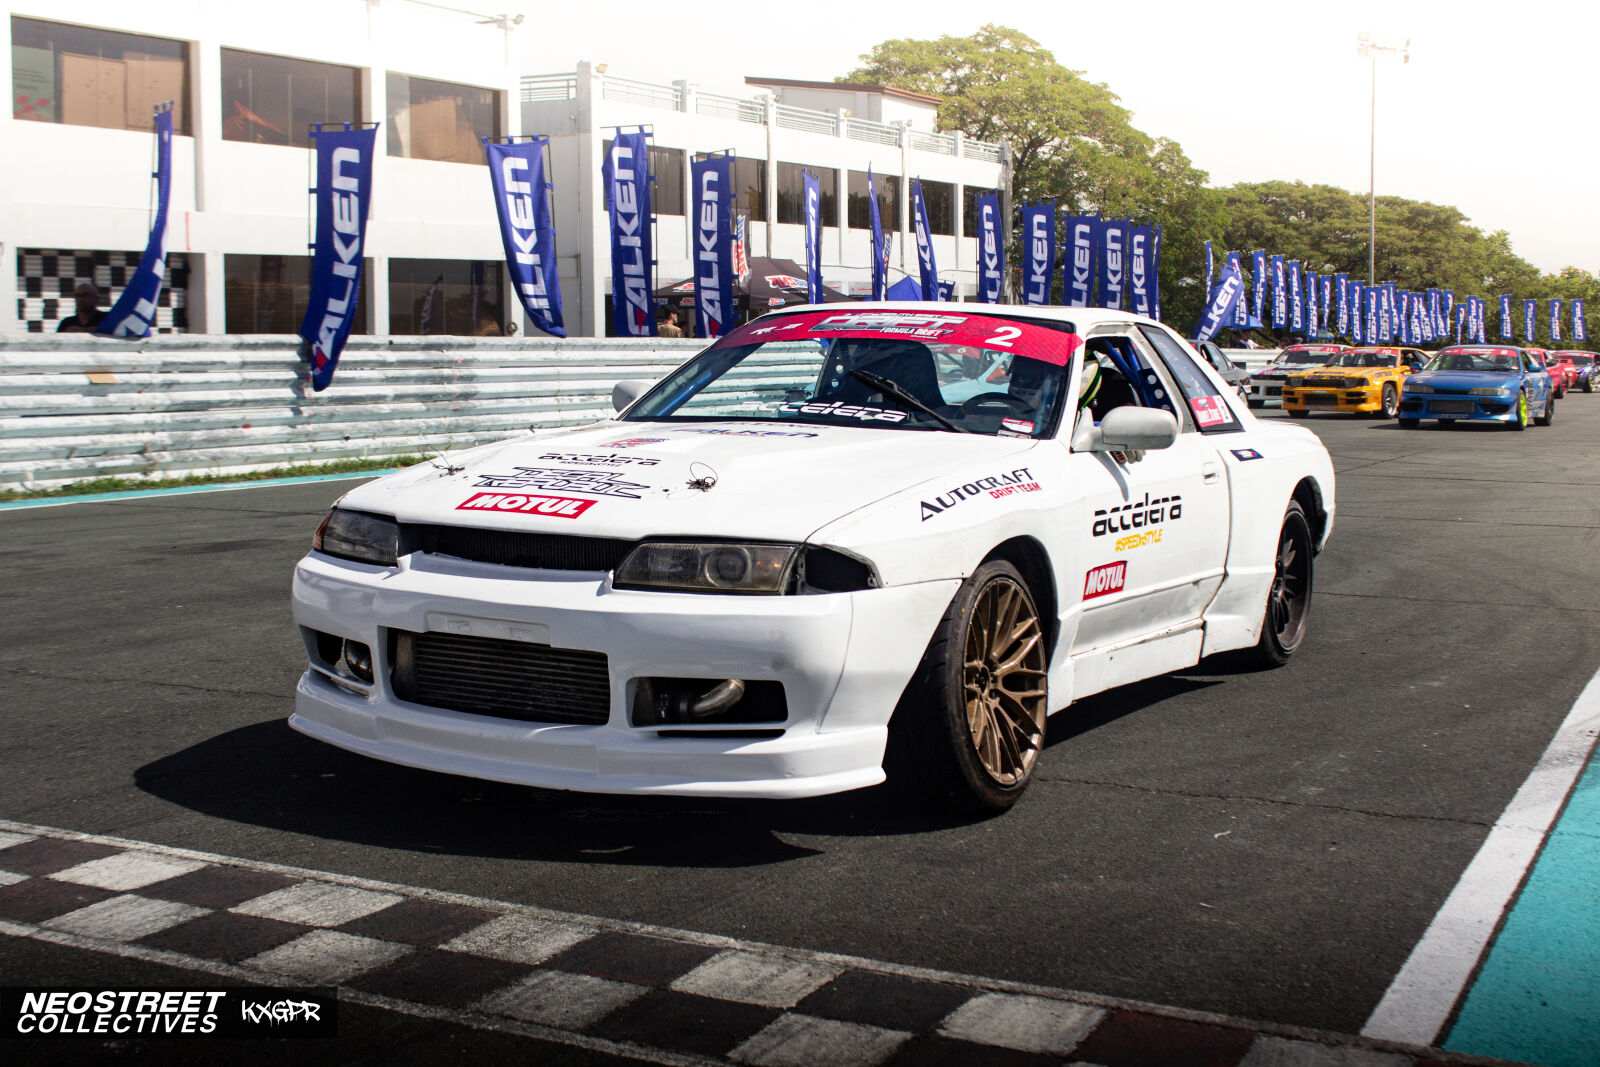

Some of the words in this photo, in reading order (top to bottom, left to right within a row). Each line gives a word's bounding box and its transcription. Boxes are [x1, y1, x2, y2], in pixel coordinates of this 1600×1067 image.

[612, 147, 650, 337] FALKEN
[983, 205, 1000, 304] LKEN
[1028, 214, 1048, 306] LKEN
[880, 327, 914, 335] FORMULA
[913, 328, 943, 337] DRIFT
[984, 325, 1022, 347] 2
[735, 401, 908, 423] accelera
[538, 452, 662, 466] accelera
[920, 467, 1038, 522] AUTOCRAFT
[988, 486, 1019, 500] DRIFT
[1016, 482, 1043, 493] TEAM
[465, 495, 585, 515] MOTUL
[1092, 492, 1182, 537] accelera
[1085, 564, 1125, 596] MOTUL
